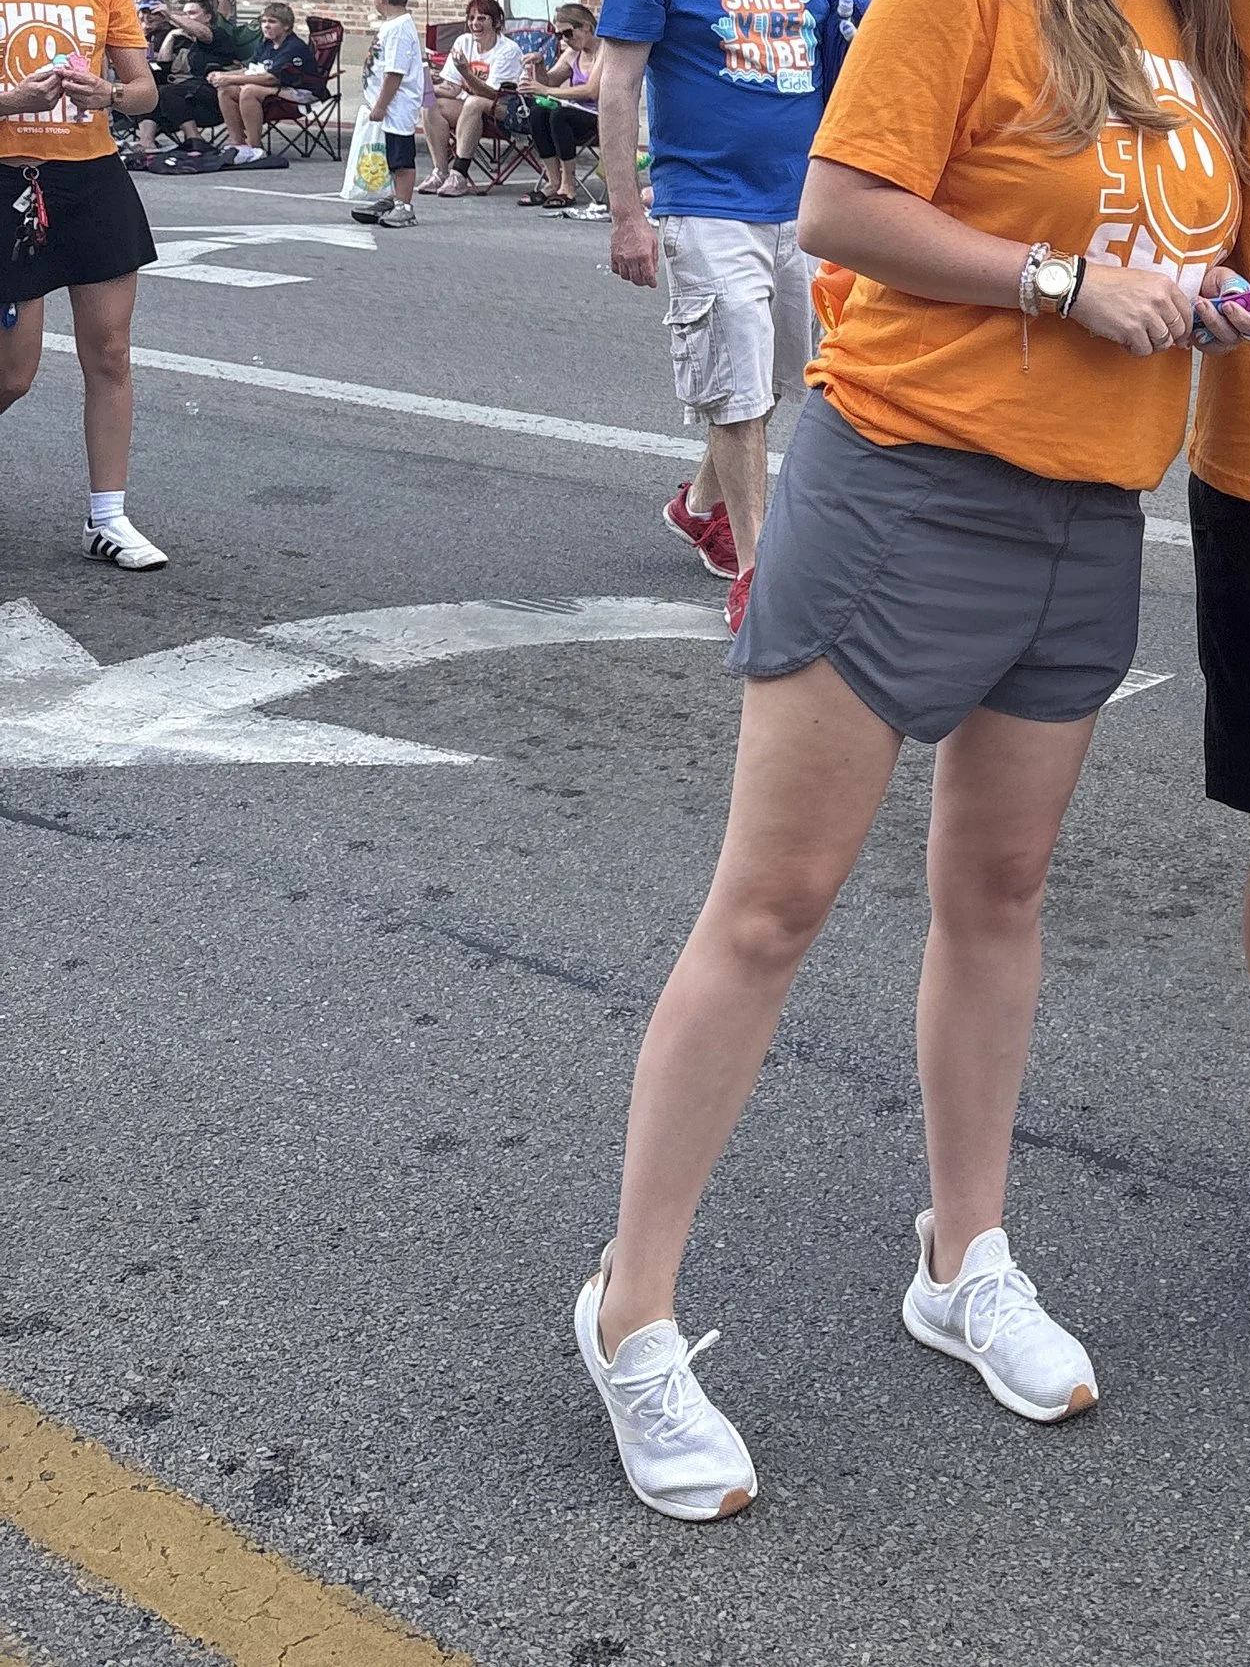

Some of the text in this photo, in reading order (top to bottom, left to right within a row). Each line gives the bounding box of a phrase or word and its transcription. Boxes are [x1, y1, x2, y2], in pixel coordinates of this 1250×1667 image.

[0, 2, 97, 43] HINE
[17, 126, 71, 135] ORTHO STUDIO
